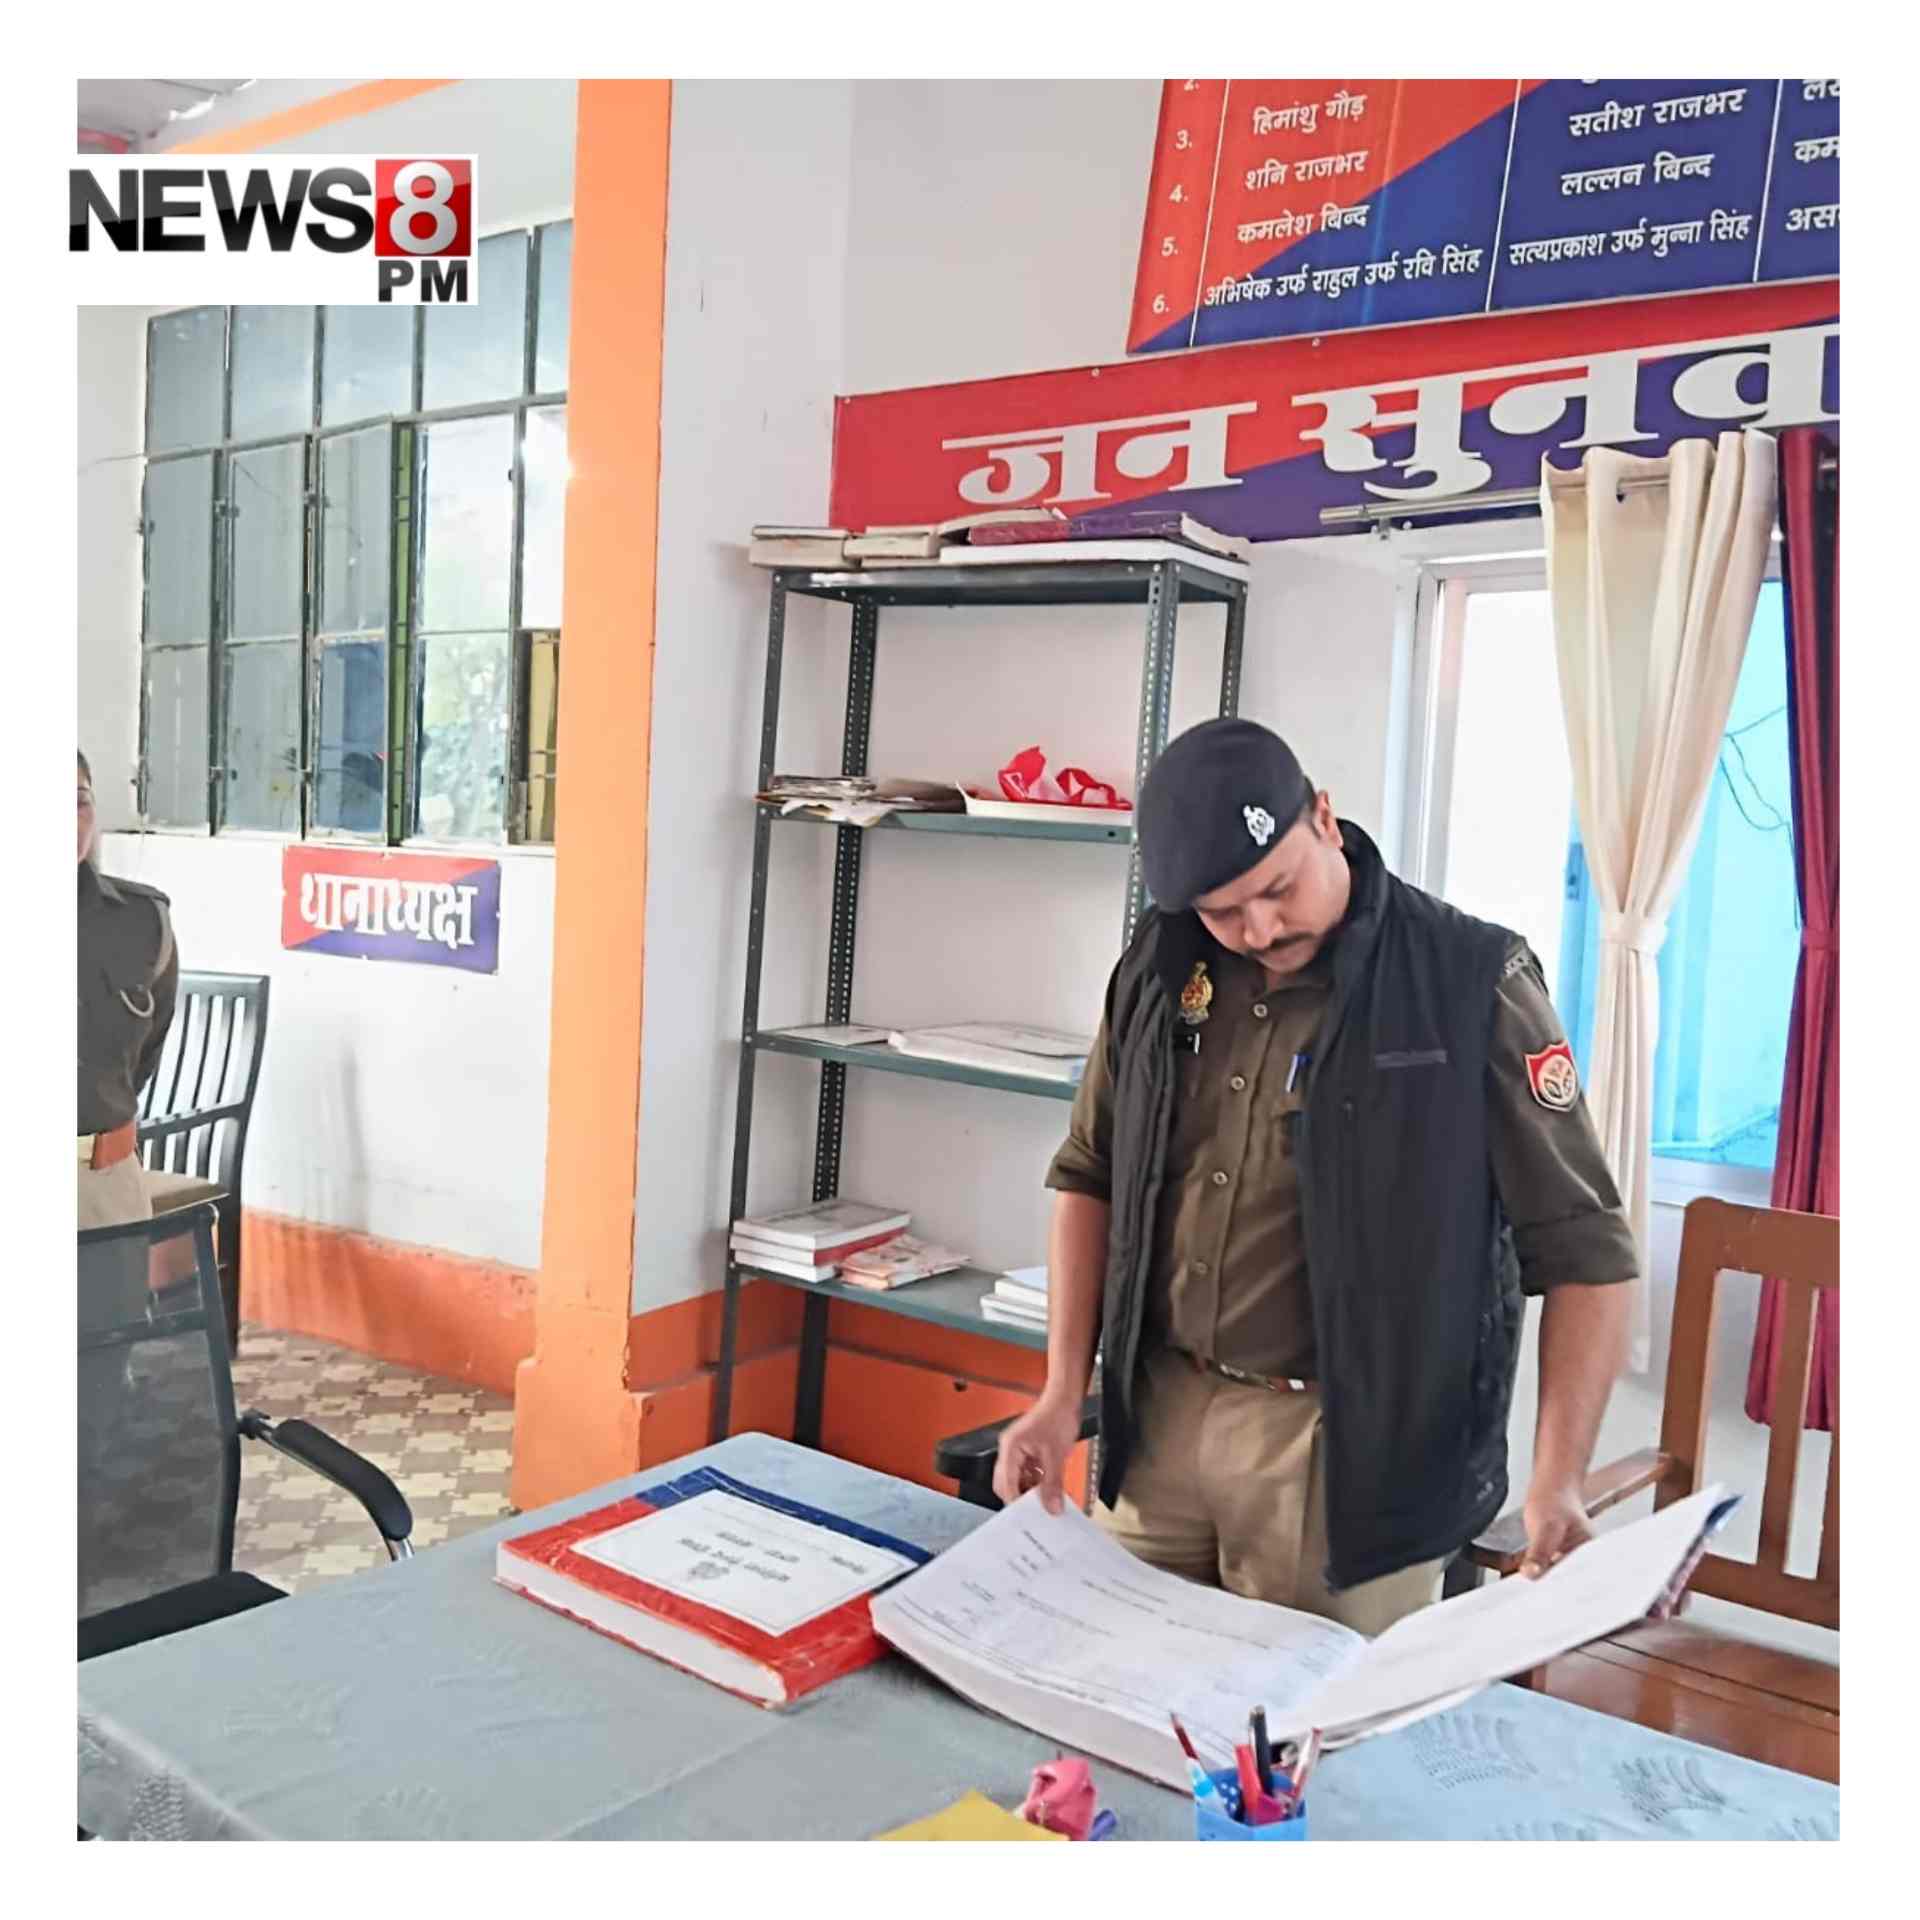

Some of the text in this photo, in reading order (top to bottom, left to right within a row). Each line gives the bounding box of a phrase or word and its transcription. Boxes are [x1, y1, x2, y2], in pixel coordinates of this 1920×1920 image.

[1253, 90, 1367, 135] हिमांशु गौड़
[1569, 88, 1747, 137] सतीश राजभर
[1176, 130, 1193, 149] 3.
[1245, 150, 1368, 190] शनि राजभर
[1560, 151, 1715, 195] लल्लन बिन्द
[1169, 184, 1188, 202] 4.
[1237, 202, 1370, 244] कमलेश बिन्द
[1510, 209, 1752, 265] सत्यप्रकाश उर्फ मुन्ना सिंह
[1161, 236, 1178, 256] 5.
[1204, 244, 1483, 307] अभिषेक उर्फ राहुल उर्फ रवि सिंह
[1152, 295, 1169, 313] 6.
[941, 401, 1258, 505] जन
[301, 872, 478, 949] थानाध्यक्ष
